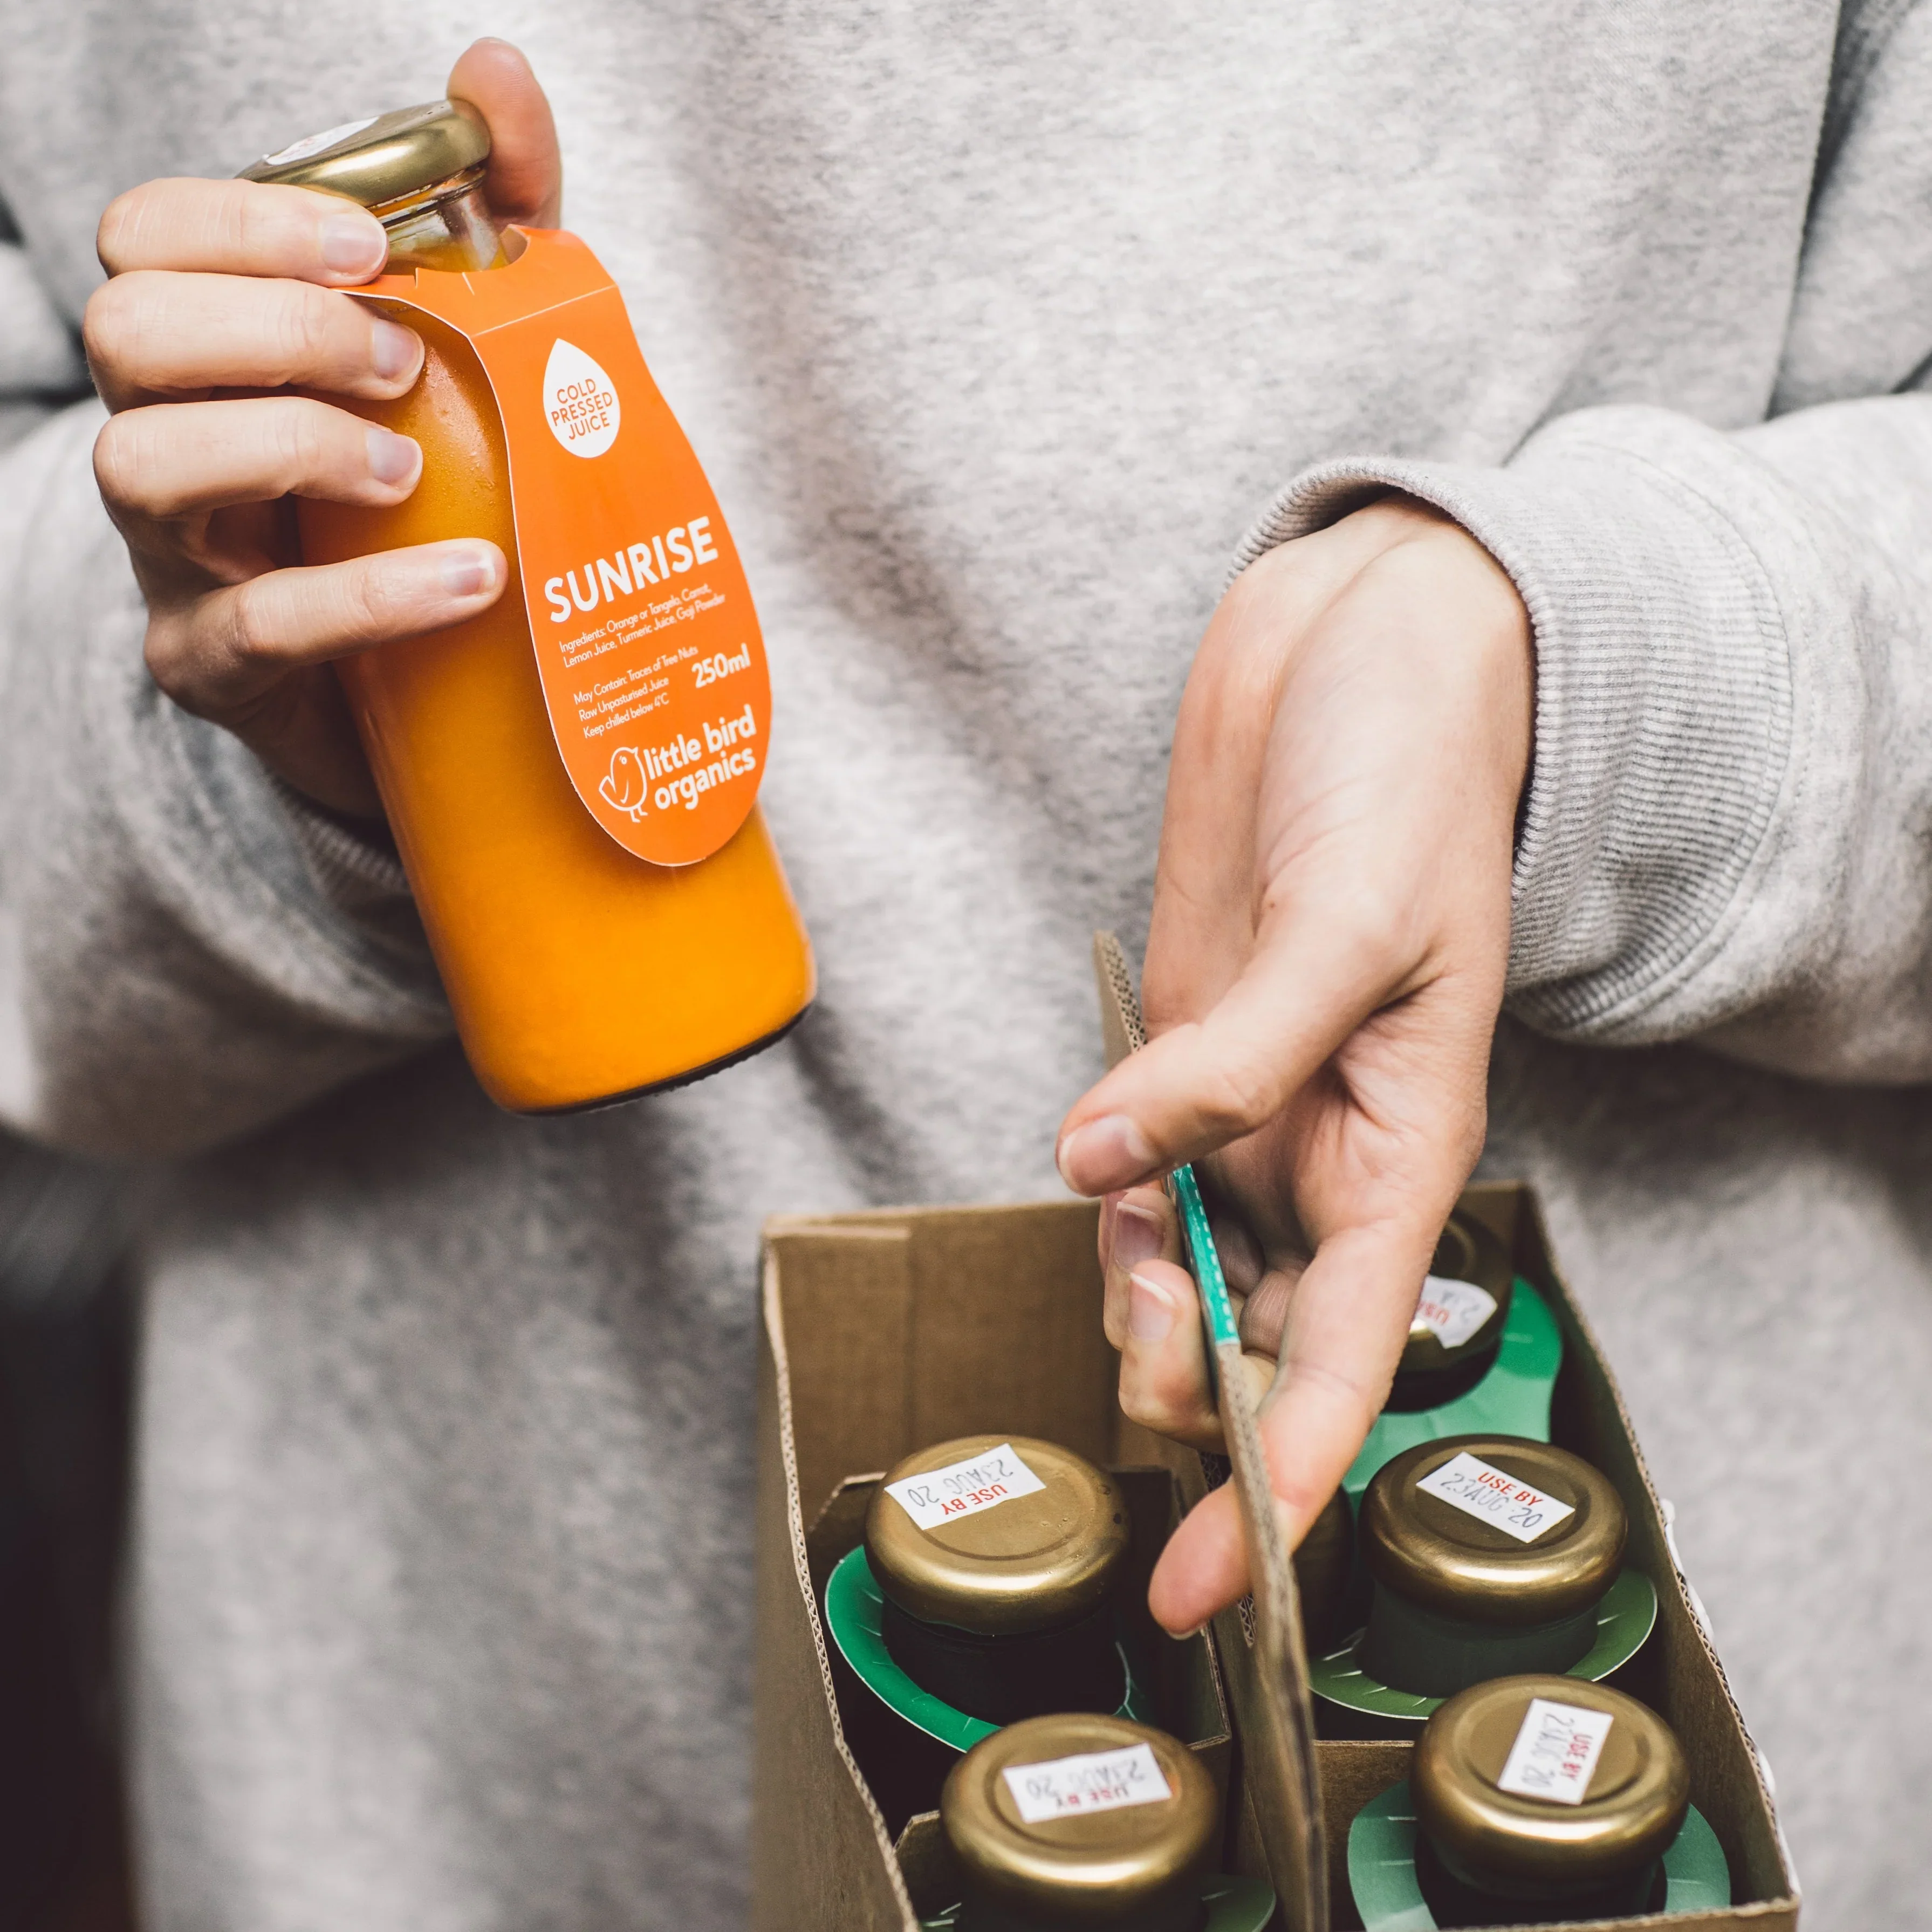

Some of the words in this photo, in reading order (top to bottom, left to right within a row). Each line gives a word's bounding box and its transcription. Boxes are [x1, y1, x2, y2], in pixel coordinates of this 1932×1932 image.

[557, 379, 596, 404] COLD
[551, 392, 613, 426] PRESSED
[569, 412, 610, 440] JUICE
[545, 516, 718, 622] SUNRISE
[559, 628, 606, 653] Ingredients:
[606, 614, 639, 632] Orange
[639, 610, 648, 619] or
[563, 650, 593, 668] Lemon
[594, 641, 617, 656] Juice,
[616, 624, 653, 645] Turmeric
[654, 615, 677, 631] Juice,
[676, 605, 696, 620] Goji
[695, 593, 725, 613] Powder
[573, 691, 593, 705] May
[594, 676, 628, 695] Contain:
[627, 666, 652, 681] Traces
[653, 657, 661, 672] of
[661, 655, 679, 667] Tree
[677, 646, 698, 661] Nuts
[691, 642, 751, 688] 250ml
[578, 708, 597, 721] Raw
[598, 682, 648, 712] Unpasturised
[649, 677, 669, 692] Juice
[583, 725, 605, 739] Keep
[605, 710, 630, 729] chilled
[629, 703, 654, 718] below
[654, 692, 669, 707] 4°C
[643, 734, 702, 780] little
[703, 703, 757, 753] bird
[654, 748, 756, 810] organics
[908, 1485, 940, 1507] 20
[966, 1484, 1008, 1504] USE
[1477, 1471, 1517, 1495] USE
[1514, 1490, 1543, 1506] BY
[941, 1498, 968, 1515] BY
[1566, 1733, 1594, 1760] USE
[1559, 1762, 1582, 1783] BY
[1056, 1793, 1081, 1808] BY
[1087, 1783, 1129, 1804] USE
